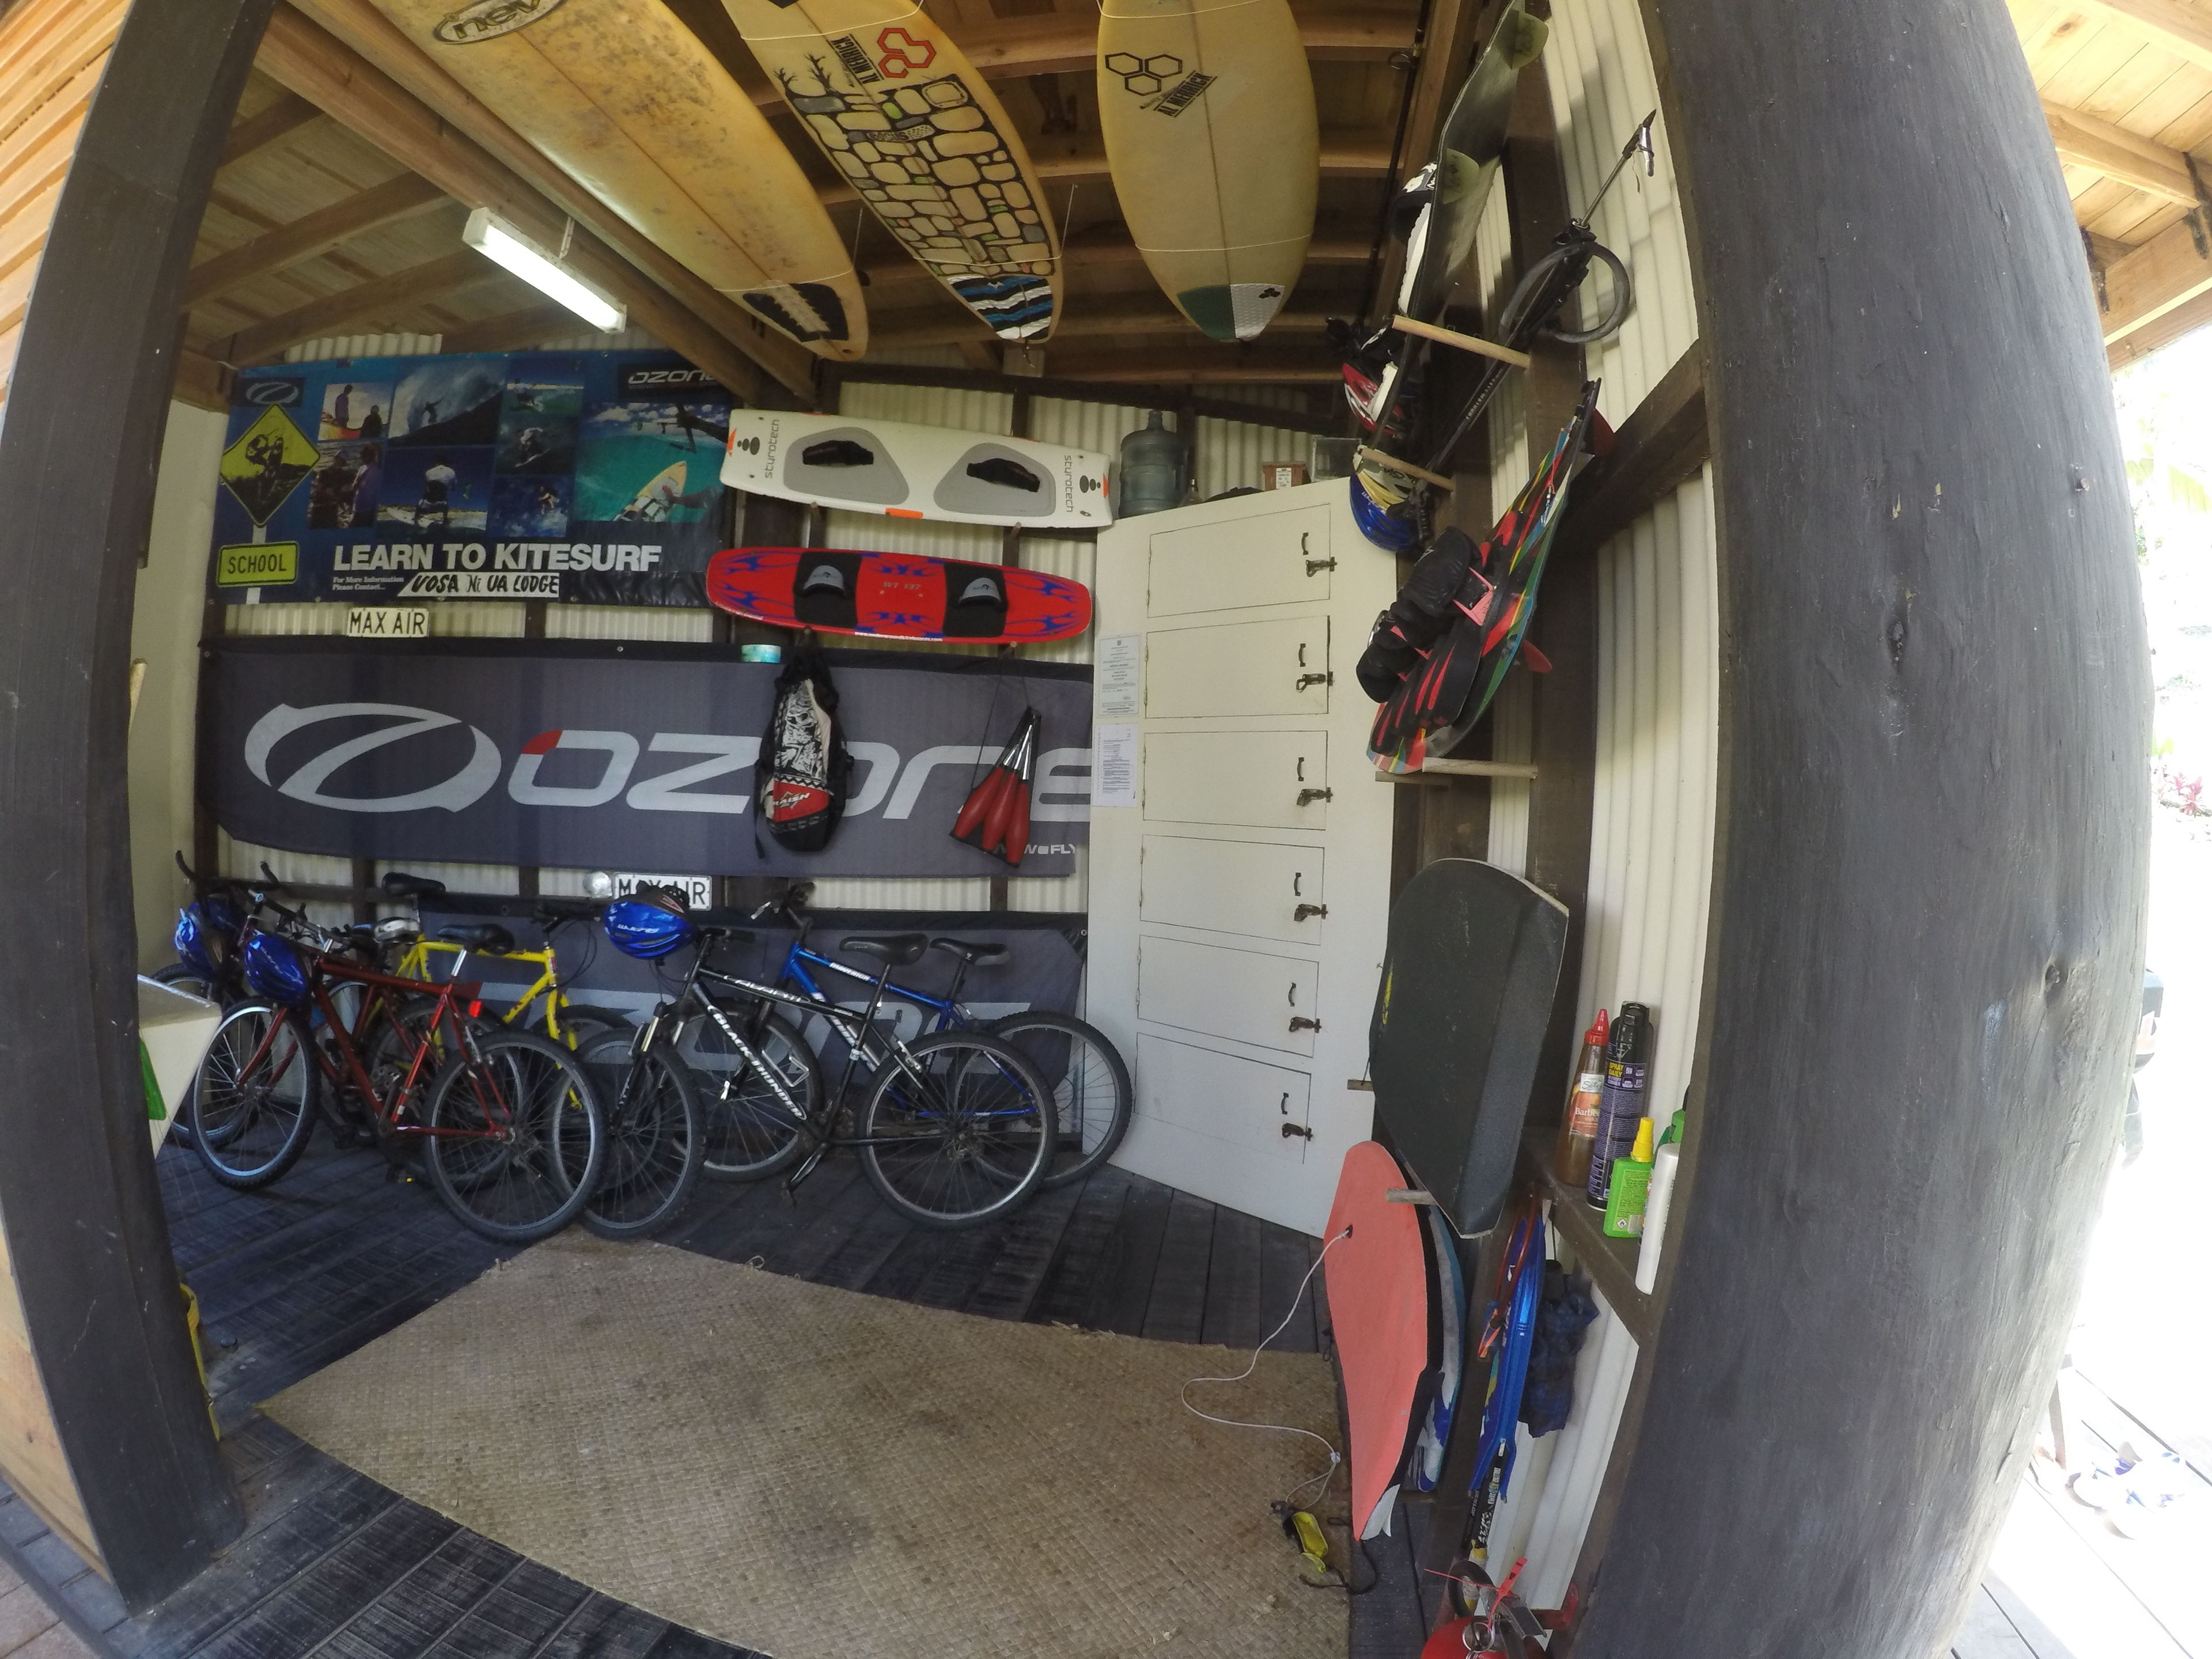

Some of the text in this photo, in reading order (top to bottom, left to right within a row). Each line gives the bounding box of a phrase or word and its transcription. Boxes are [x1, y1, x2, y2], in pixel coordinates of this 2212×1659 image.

[228, 554, 287, 574] SCHOOL
[334, 543, 662, 572] LEARN TO KITESURF
[411, 574, 459, 594] VOSA
[487, 574, 508, 593] UA
[513, 575, 559, 594] LODGE
[350, 611, 426, 634] MAX AIR
[713, 1012, 802, 1117] BLACK THUNDER
[1608, 1069, 1623, 1077] DAILY
[1609, 1062, 1624, 1071] SPRAY
